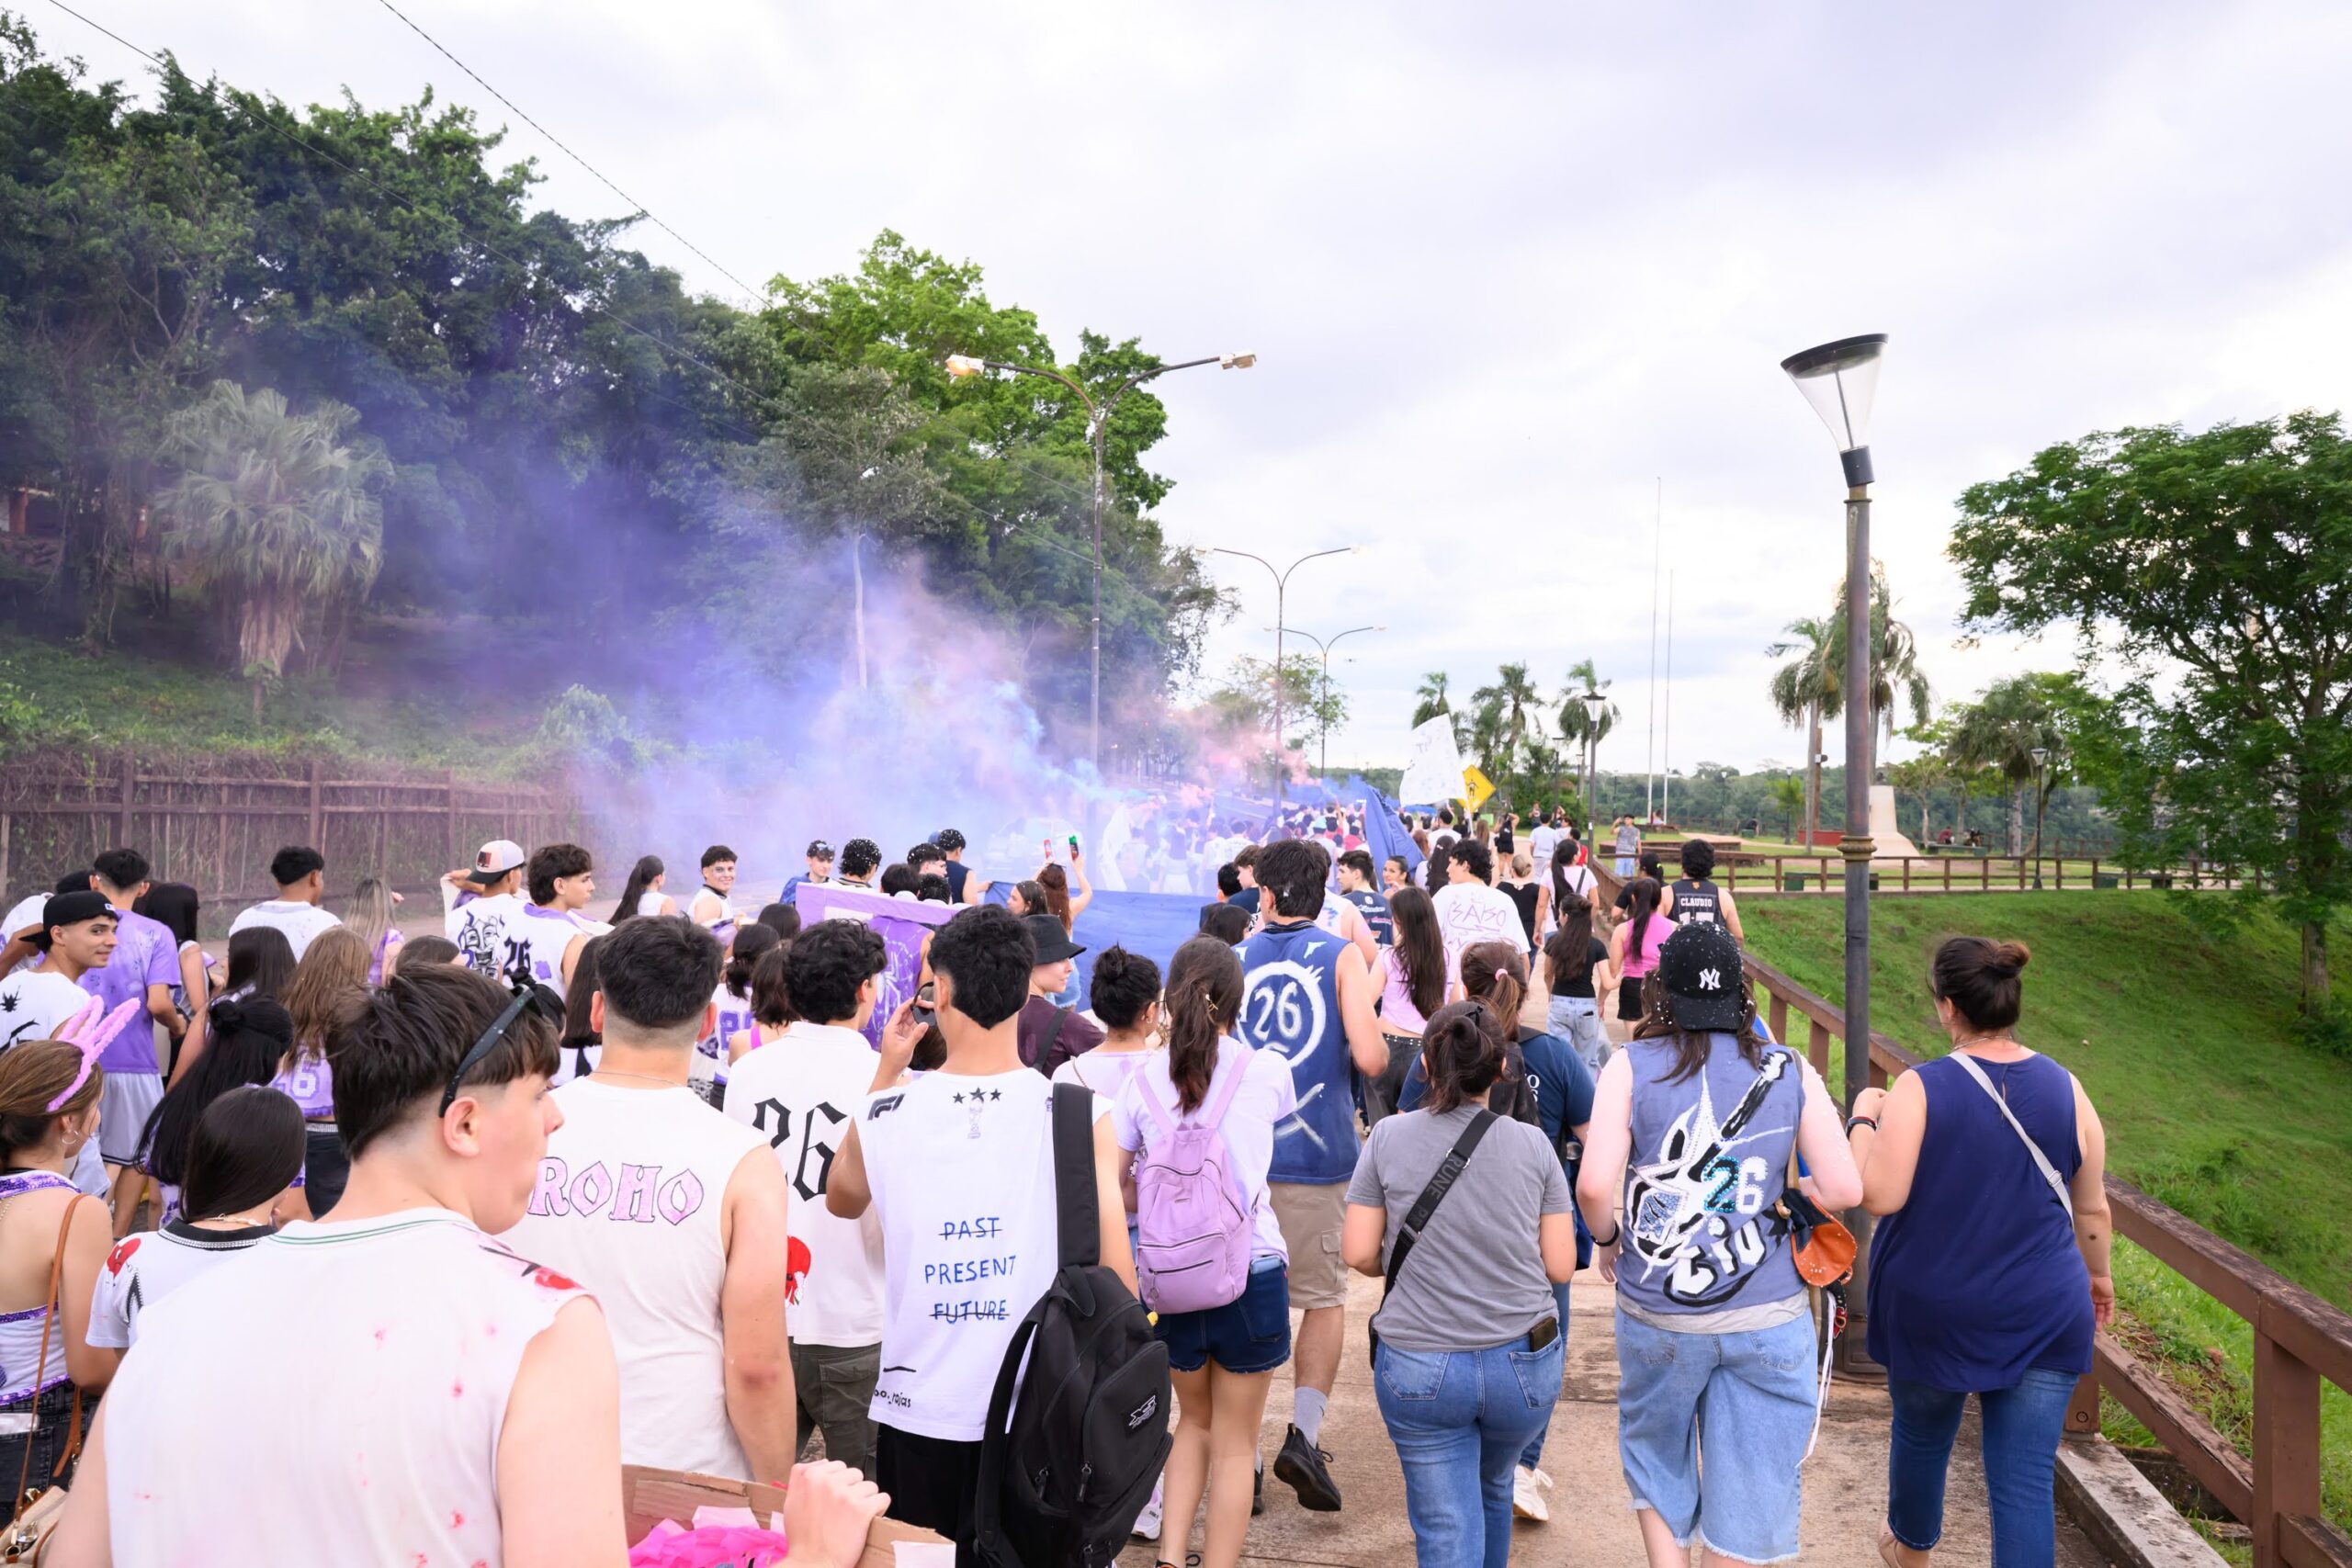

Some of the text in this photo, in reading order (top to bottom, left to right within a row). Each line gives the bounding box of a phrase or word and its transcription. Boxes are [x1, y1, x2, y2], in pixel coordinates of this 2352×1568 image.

[1680, 897, 1713, 908] CLAUDIO
[1699, 967, 1721, 990] NY
[1252, 981, 1303, 1043] 26
[1701, 1156, 1768, 1215] 26
[943, 1217, 1001, 1241] PAST
[924, 1255, 1016, 1285] PRESENT
[933, 1300, 1007, 1325] FUTURE
